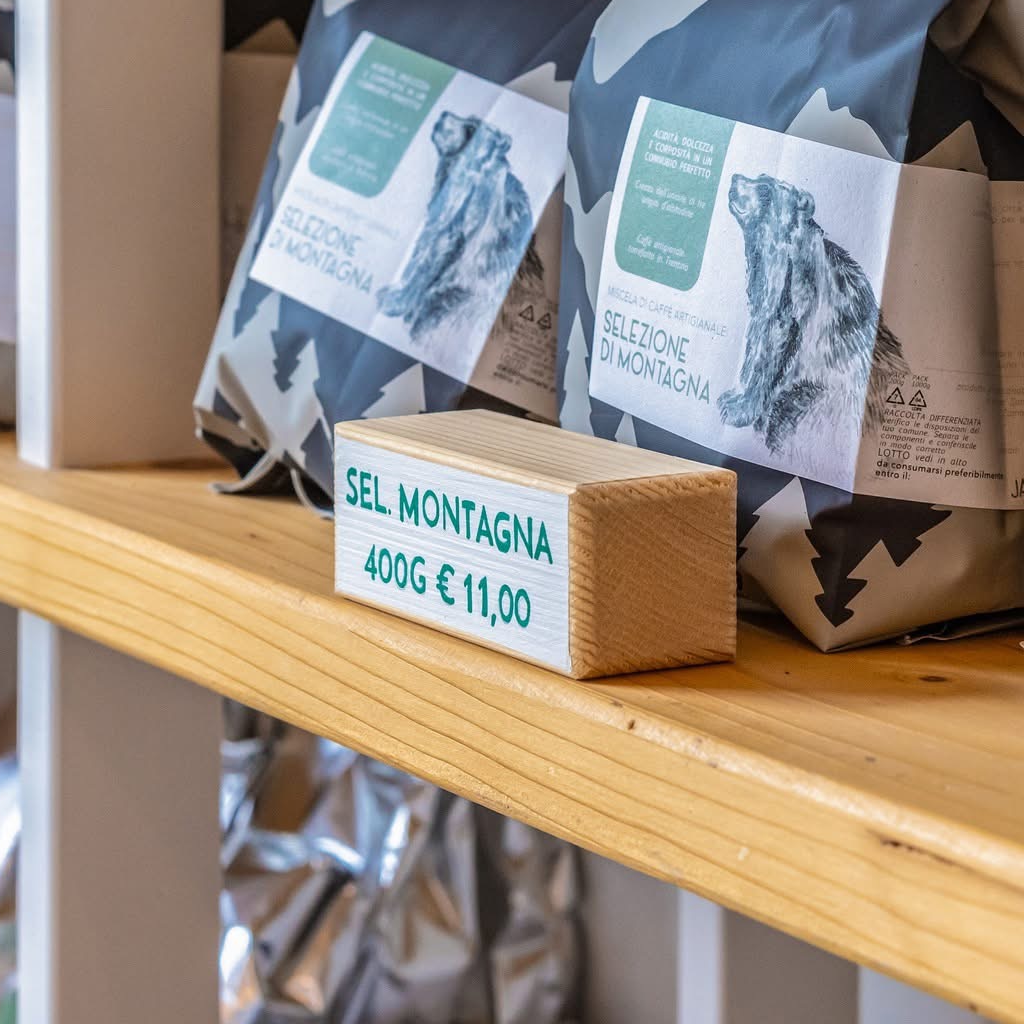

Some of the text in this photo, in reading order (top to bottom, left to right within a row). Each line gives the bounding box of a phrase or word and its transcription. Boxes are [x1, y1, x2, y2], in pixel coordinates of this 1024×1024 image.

[682, 136, 714, 153] DOLCEZZA
[679, 162, 711, 179] PERFETTO
[674, 310, 727, 337] ARTIGIANALE
[603, 309, 690, 364] SELEZIONE
[600, 337, 614, 364] DI
[617, 347, 710, 405] MONTAGNA
[884, 408, 982, 426] RACCOLTA DIFFERENZIATA
[914, 420, 921, 428] le
[924, 422, 967, 435] disposizioni
[934, 430, 960, 442] Separa
[962, 434, 969, 442] le
[880, 433, 926, 446] componenti
[890, 442, 912, 451] modo
[916, 444, 946, 455] corretto
[878, 448, 968, 468] LOTTO vedi in alto
[875, 470, 900, 480] entro
[876, 459, 888, 468] da
[891, 462, 943, 475] consumarsi
[345, 466, 554, 565] SEL. MONTAGNA
[363, 543, 532, 628] 400G € 11,00
